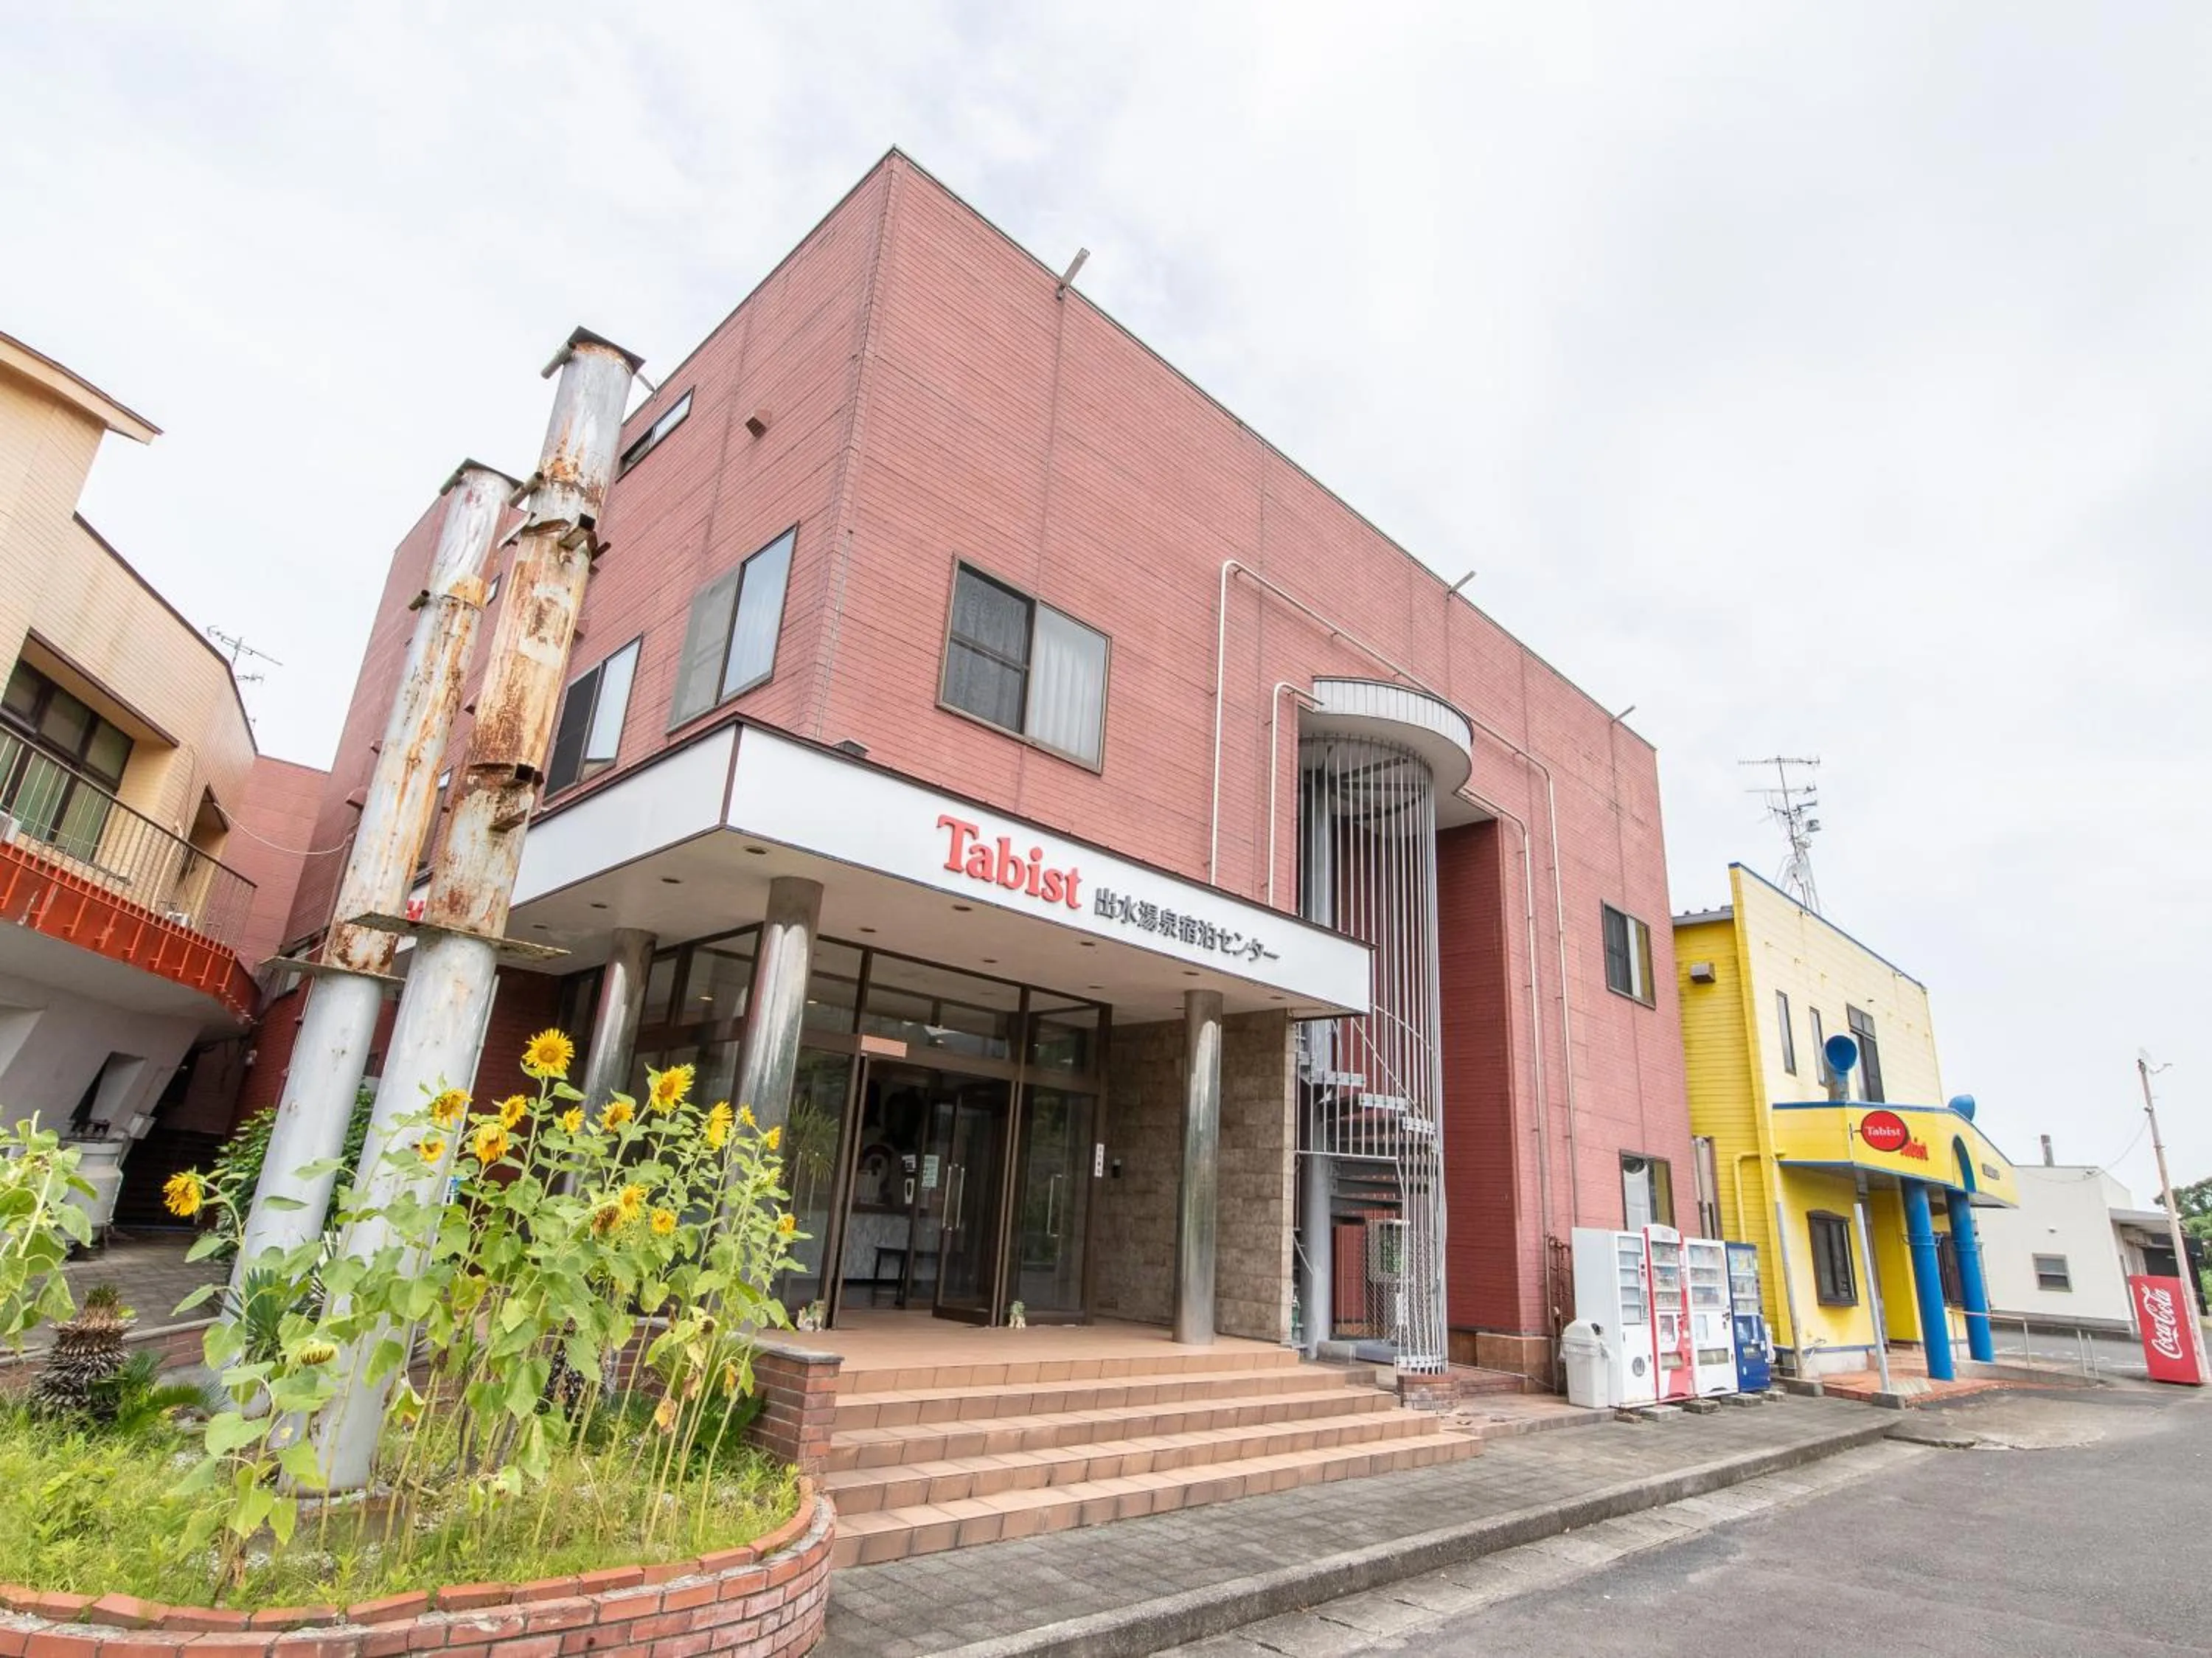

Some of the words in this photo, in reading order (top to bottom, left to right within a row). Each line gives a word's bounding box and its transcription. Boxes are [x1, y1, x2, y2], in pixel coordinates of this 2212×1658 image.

[936, 814, 1082, 909] Tabist
[1093, 887, 1281, 962] 出水湯泉宿泊センター
[1865, 1125, 1902, 1137] Tabist
